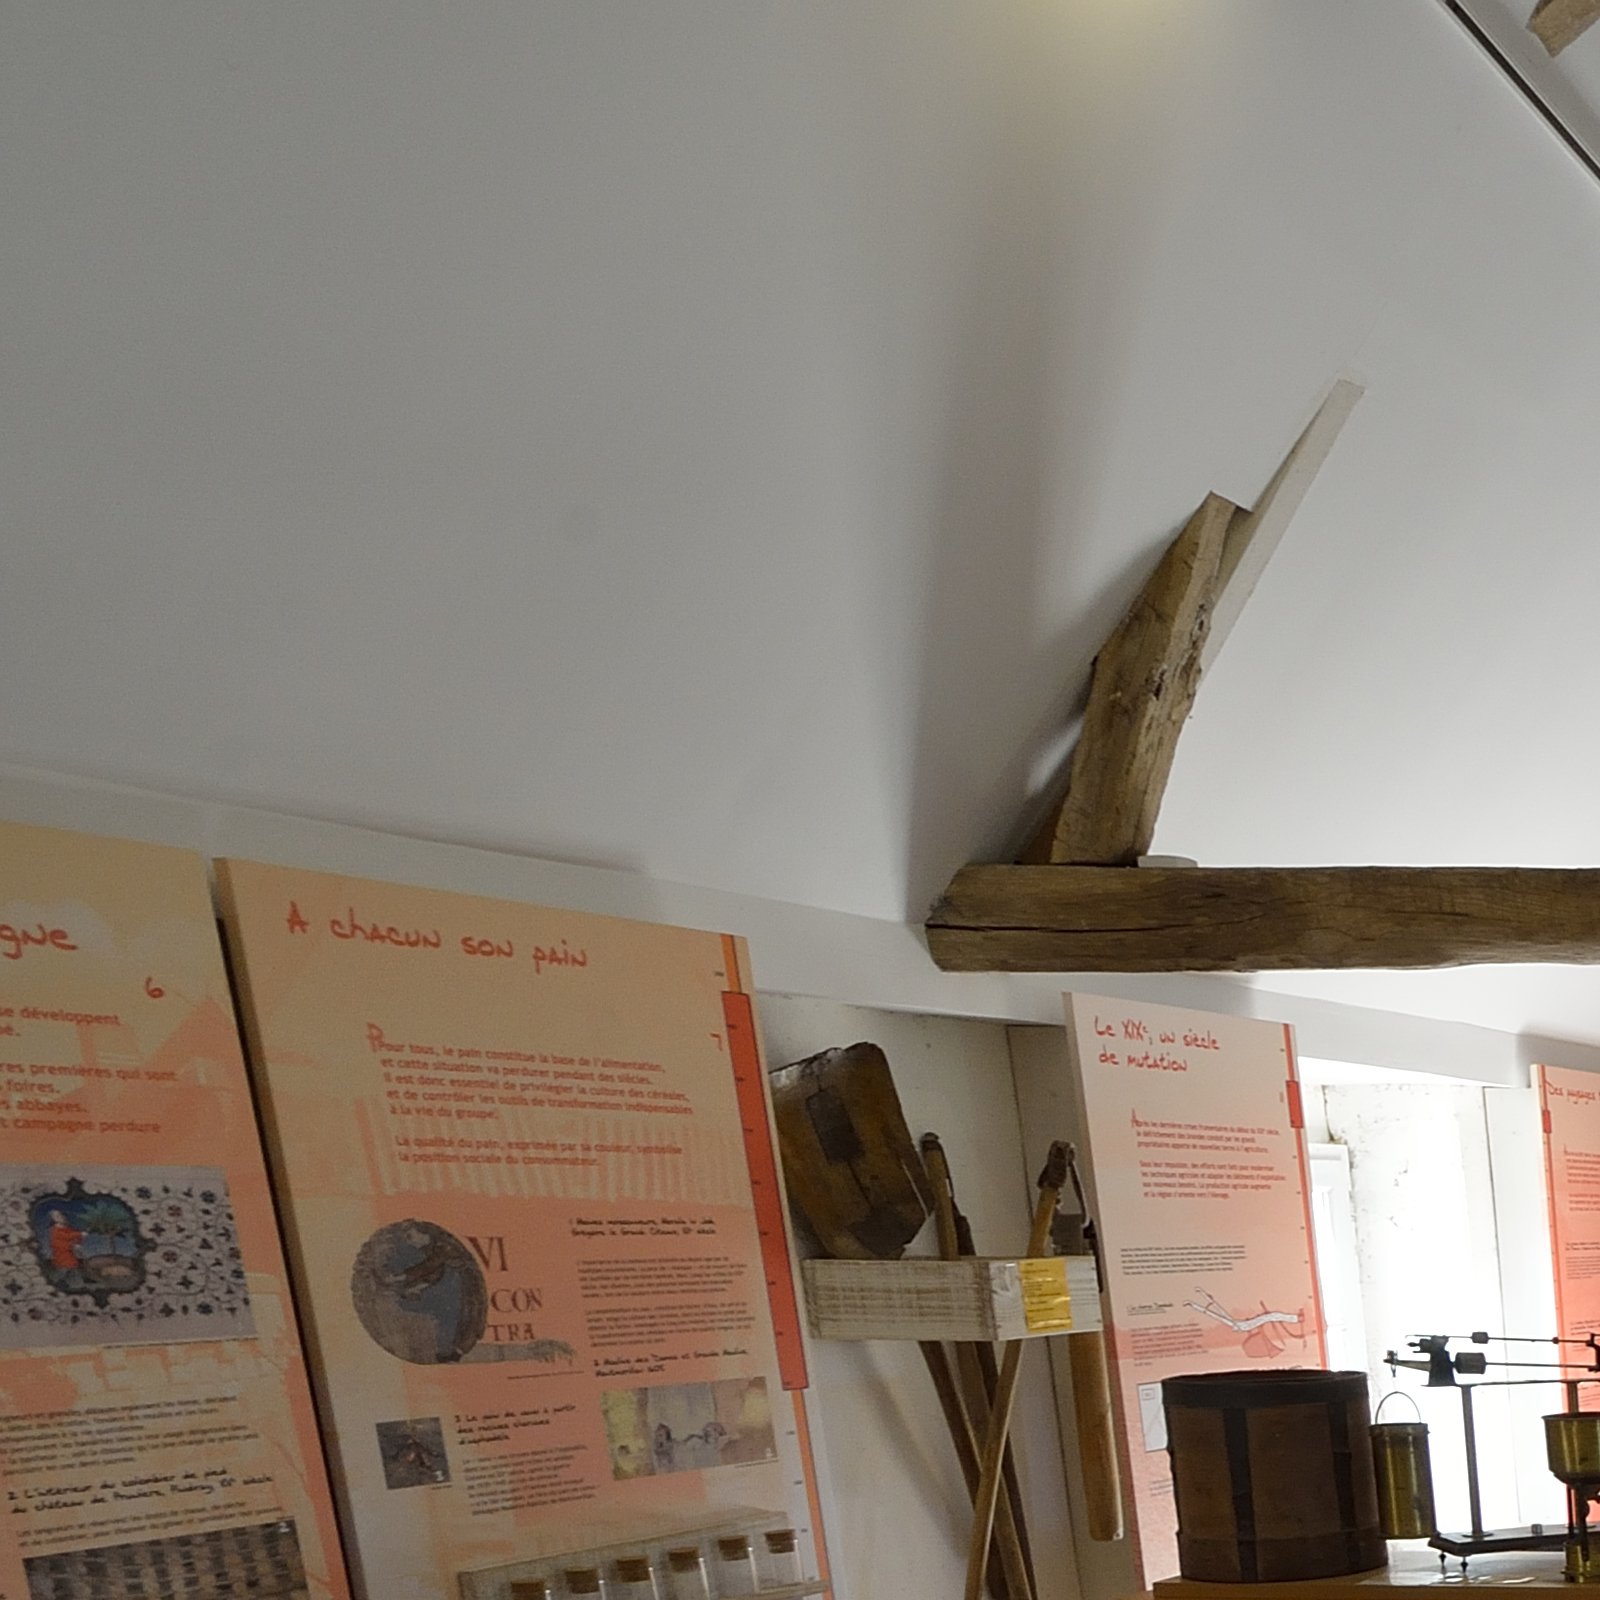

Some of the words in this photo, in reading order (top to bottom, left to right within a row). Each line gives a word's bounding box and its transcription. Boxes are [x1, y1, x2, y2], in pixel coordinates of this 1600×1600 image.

[328, 905, 442, 951] chacun
[460, 935, 515, 959] son
[532, 938, 589, 975] pain
[143, 976, 167, 999] 6
[19, 1005, 121, 1025] développent
[1093, 1014, 1117, 1038] Le
[1158, 1031, 1176, 1045] un
[1182, 1027, 1221, 1051] siècle
[1098, 1043, 1120, 1066] de
[1126, 1050, 1188, 1073] mutation
